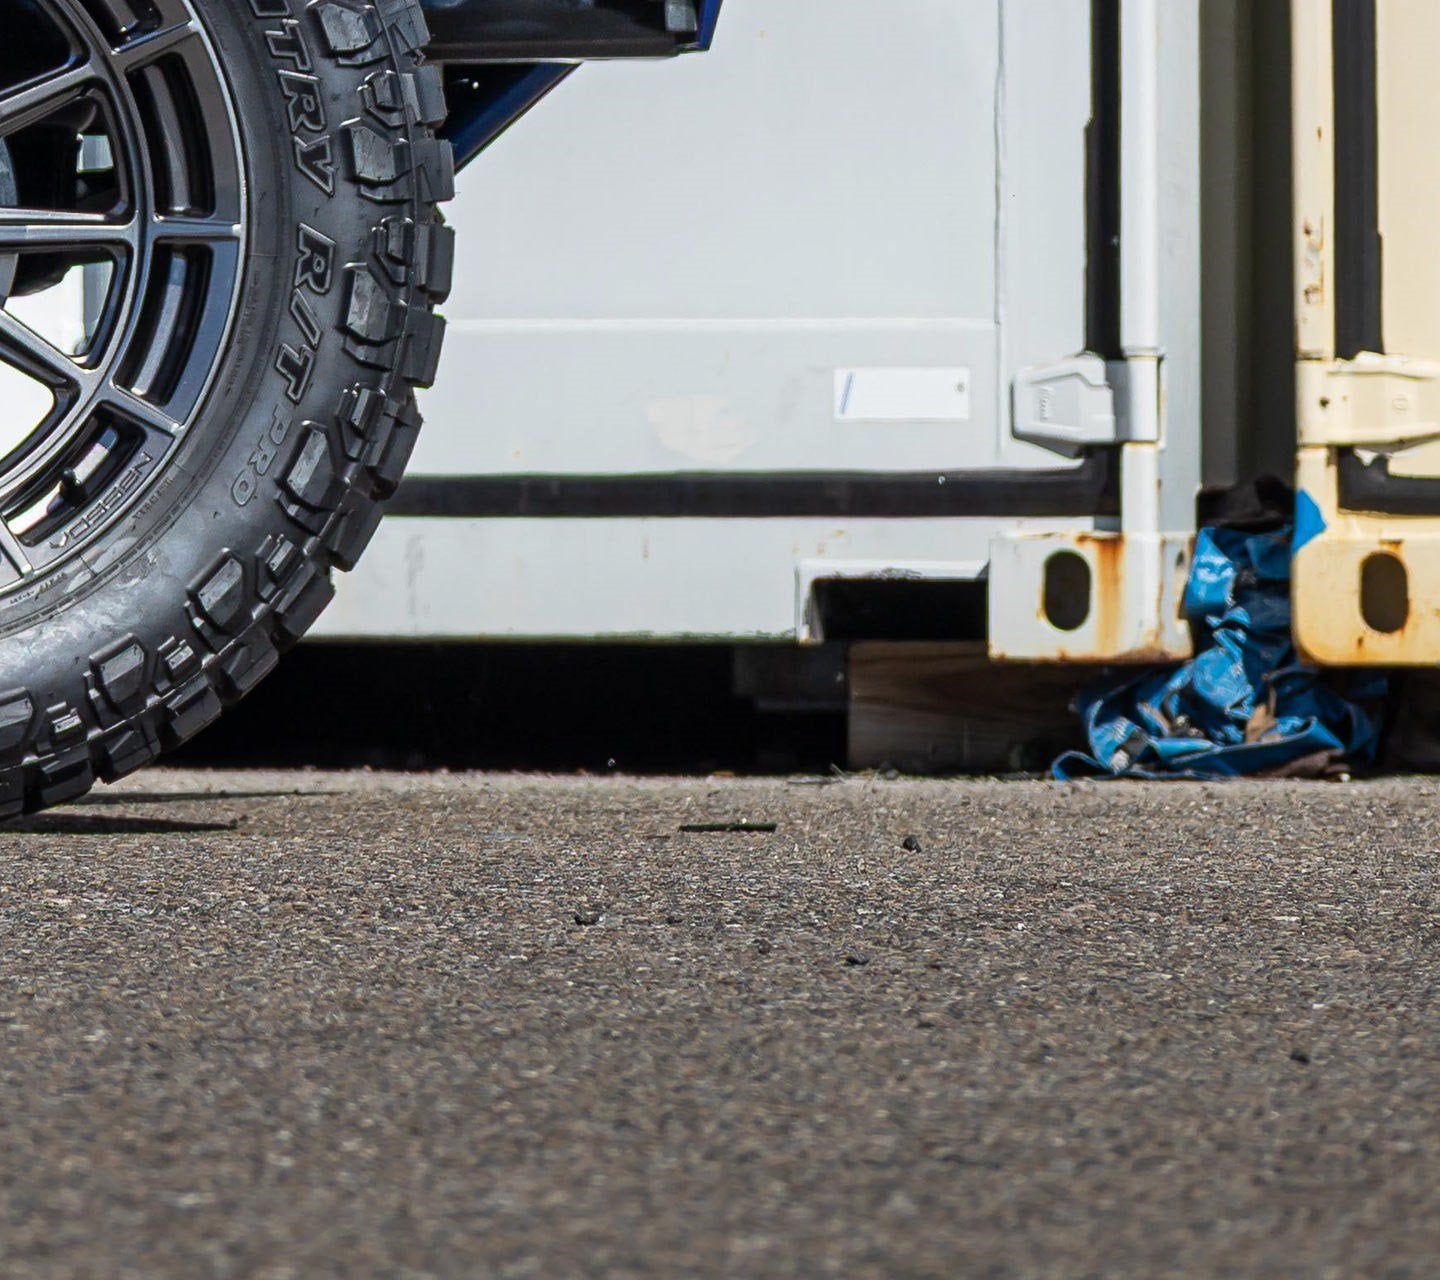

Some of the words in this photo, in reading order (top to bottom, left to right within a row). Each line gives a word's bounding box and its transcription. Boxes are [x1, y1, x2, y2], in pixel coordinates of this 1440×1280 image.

[274, 222, 337, 405] R/T
[48, 450, 154, 549] VOSSEN
[231, 403, 293, 507] PRO
